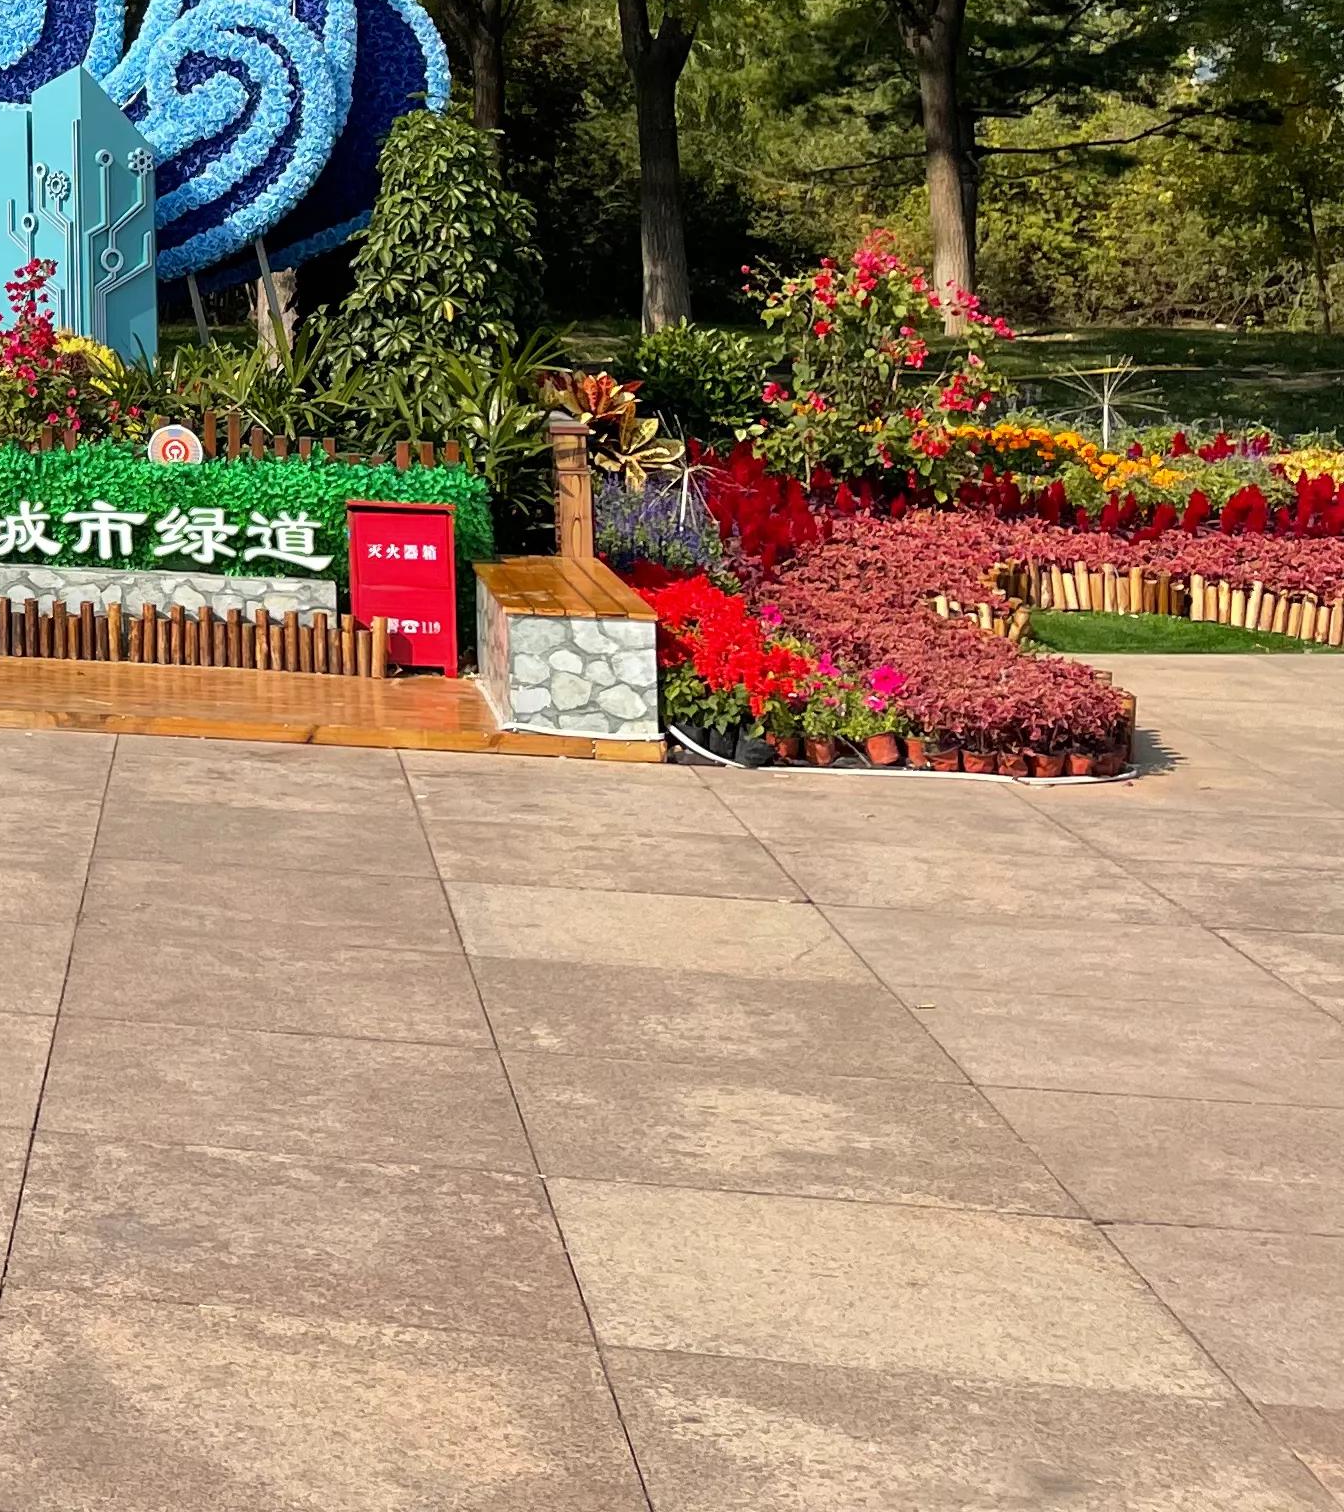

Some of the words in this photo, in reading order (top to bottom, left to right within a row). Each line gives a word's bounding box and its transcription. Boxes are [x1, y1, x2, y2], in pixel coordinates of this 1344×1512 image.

[367, 543, 437, 560] 灭火器箱
[421, 621, 441, 634] 119
